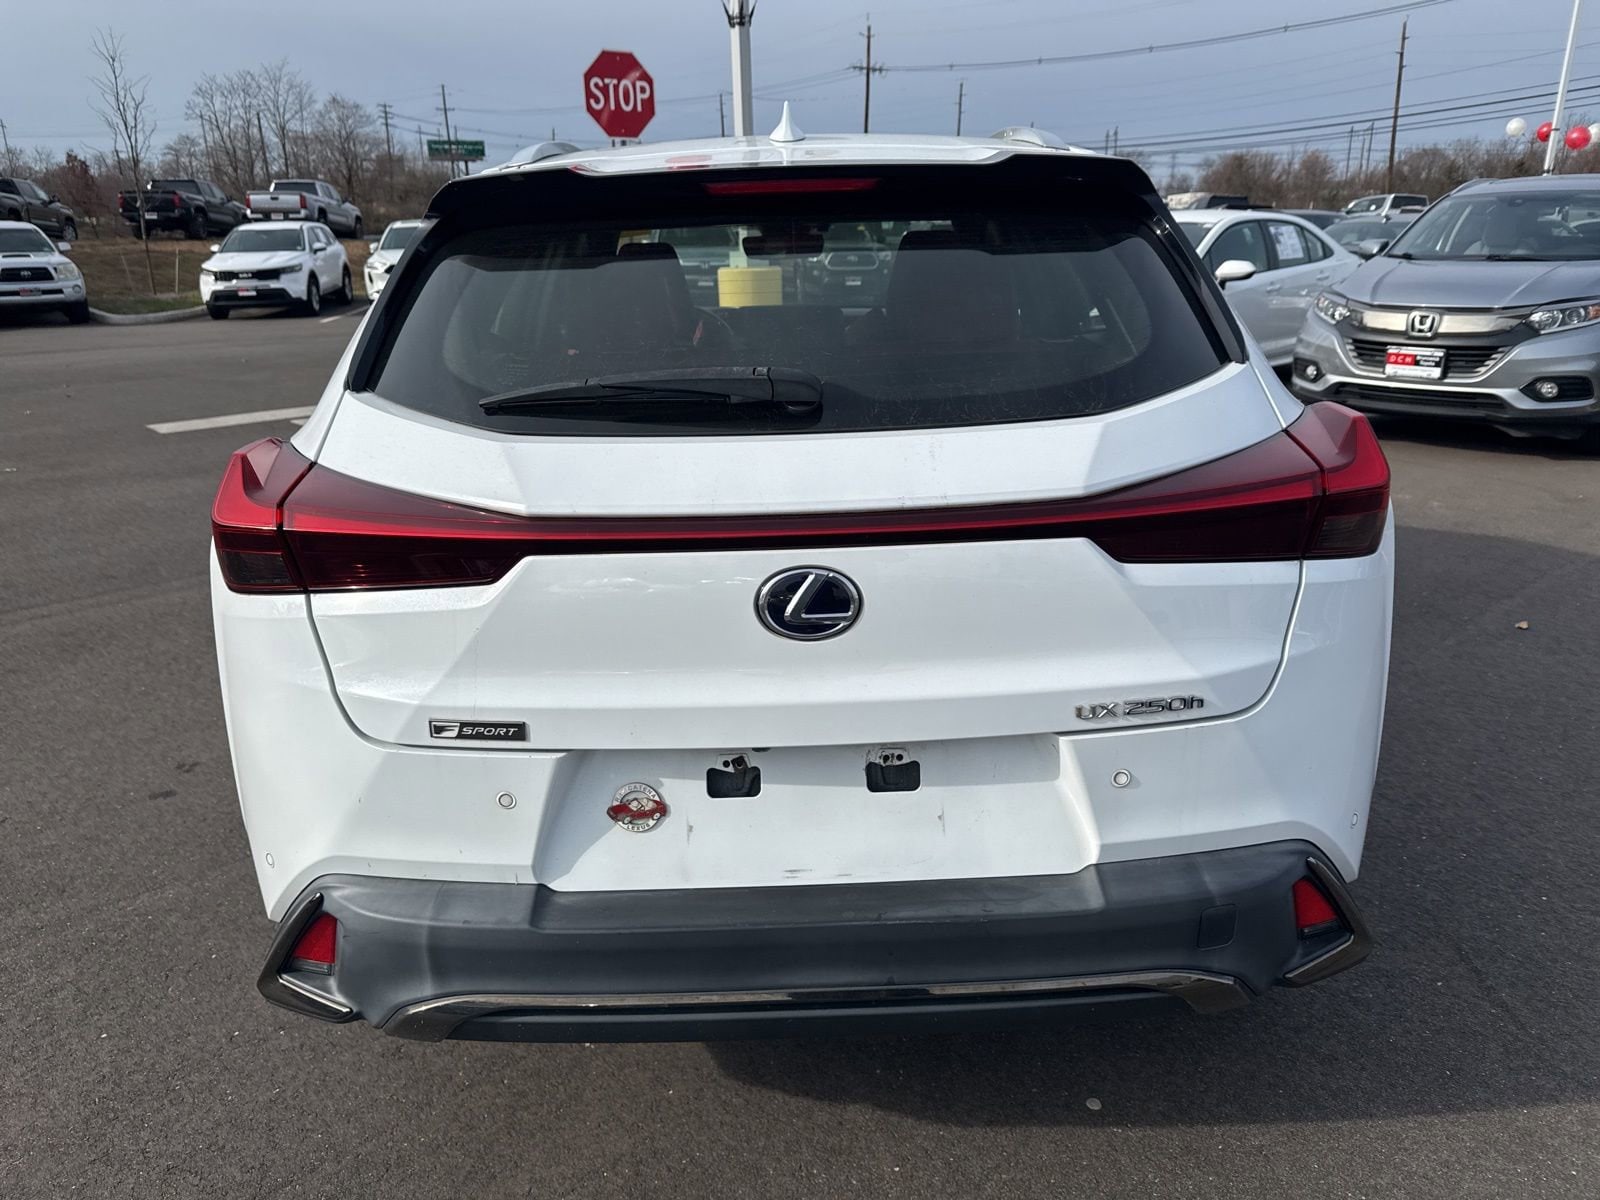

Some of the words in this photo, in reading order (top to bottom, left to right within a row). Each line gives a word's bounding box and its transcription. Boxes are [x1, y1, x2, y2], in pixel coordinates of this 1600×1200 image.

[589, 76, 651, 112] STOP
[1075, 703, 1119, 719] UX
[1123, 695, 1205, 715] 250h
[461, 726, 518, 736] SPORT
[627, 823, 651, 831] LEXUS
